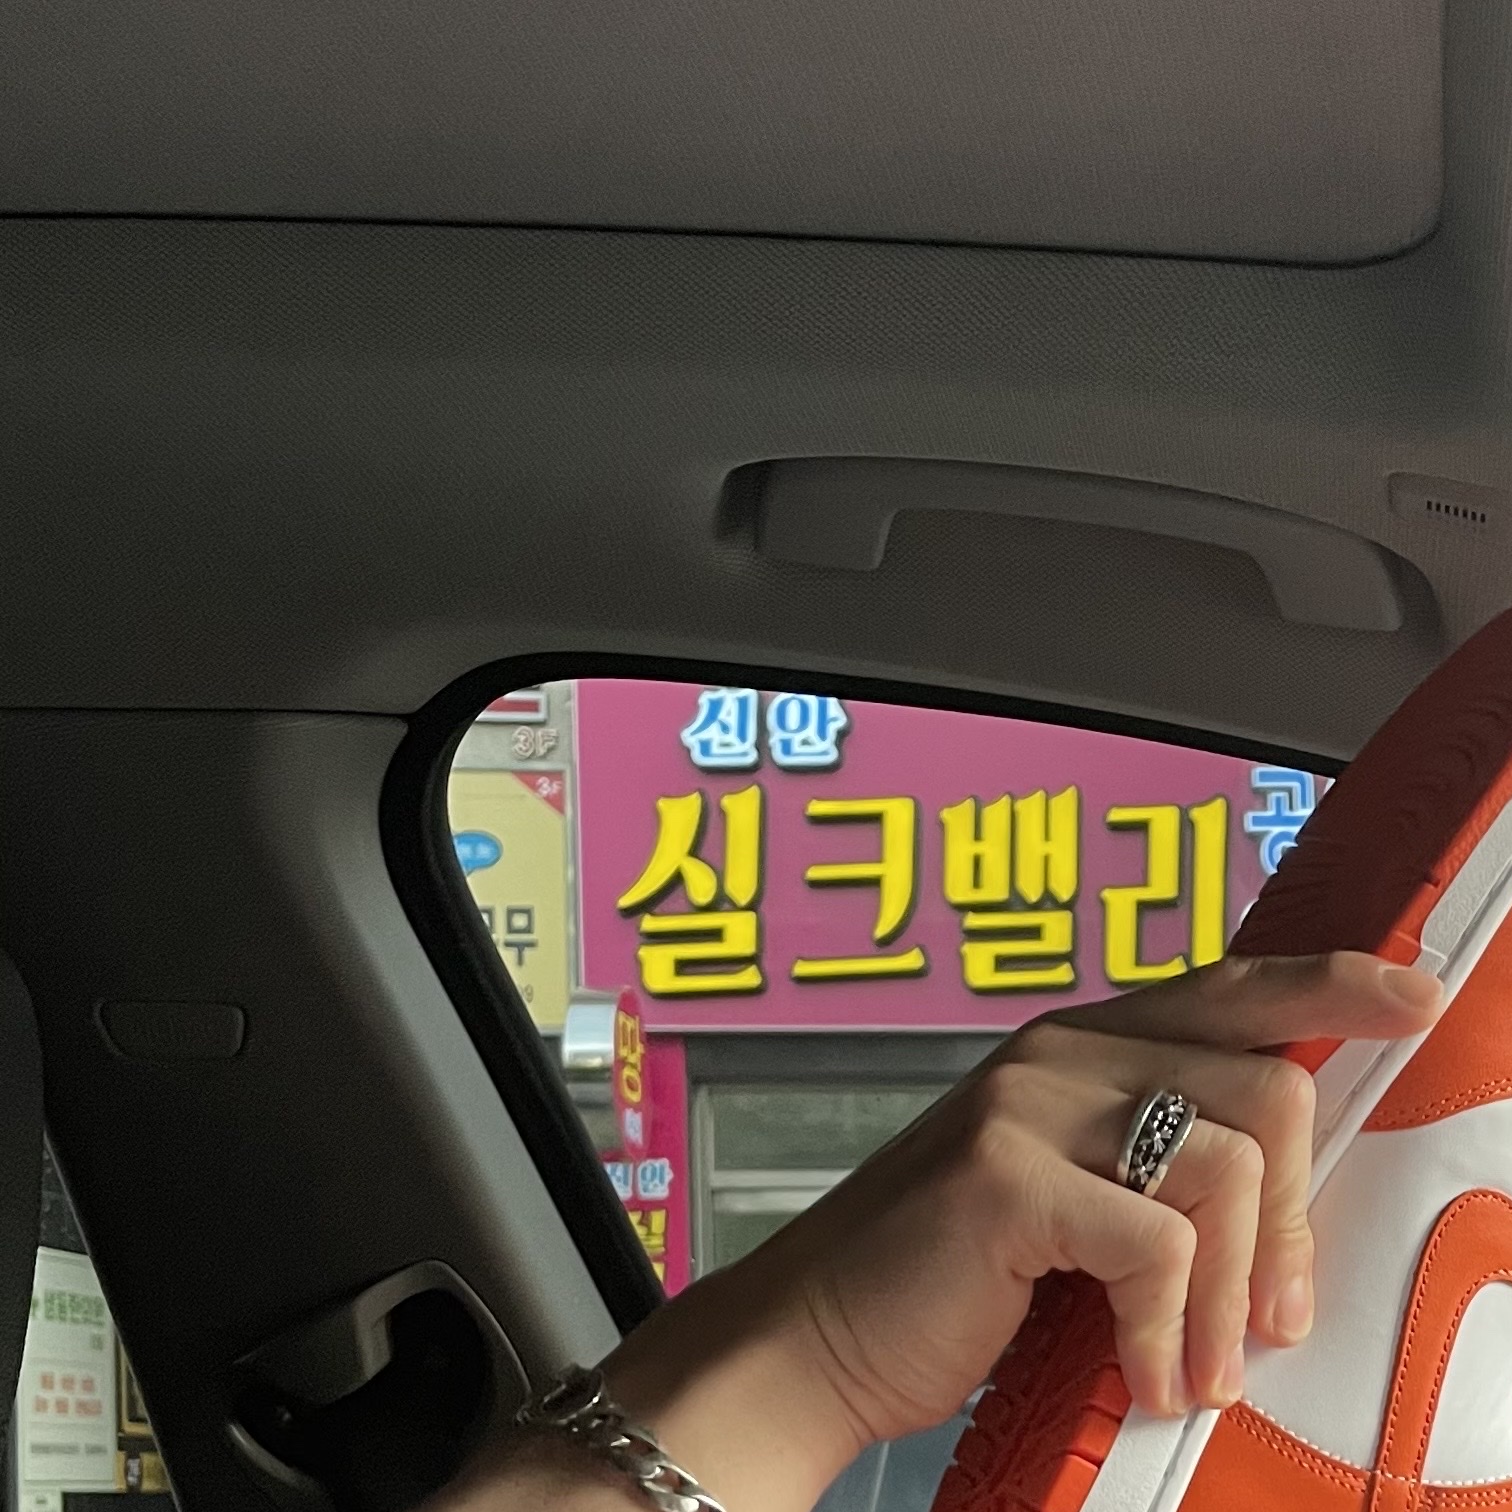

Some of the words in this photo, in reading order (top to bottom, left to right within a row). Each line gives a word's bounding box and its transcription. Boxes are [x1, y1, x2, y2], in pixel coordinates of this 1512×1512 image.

[512, 726, 558, 759] 3F
[682, 689, 847, 768] 신안
[1244, 767, 1318, 876] 공
[616, 783, 1230, 996] 실크밸리
